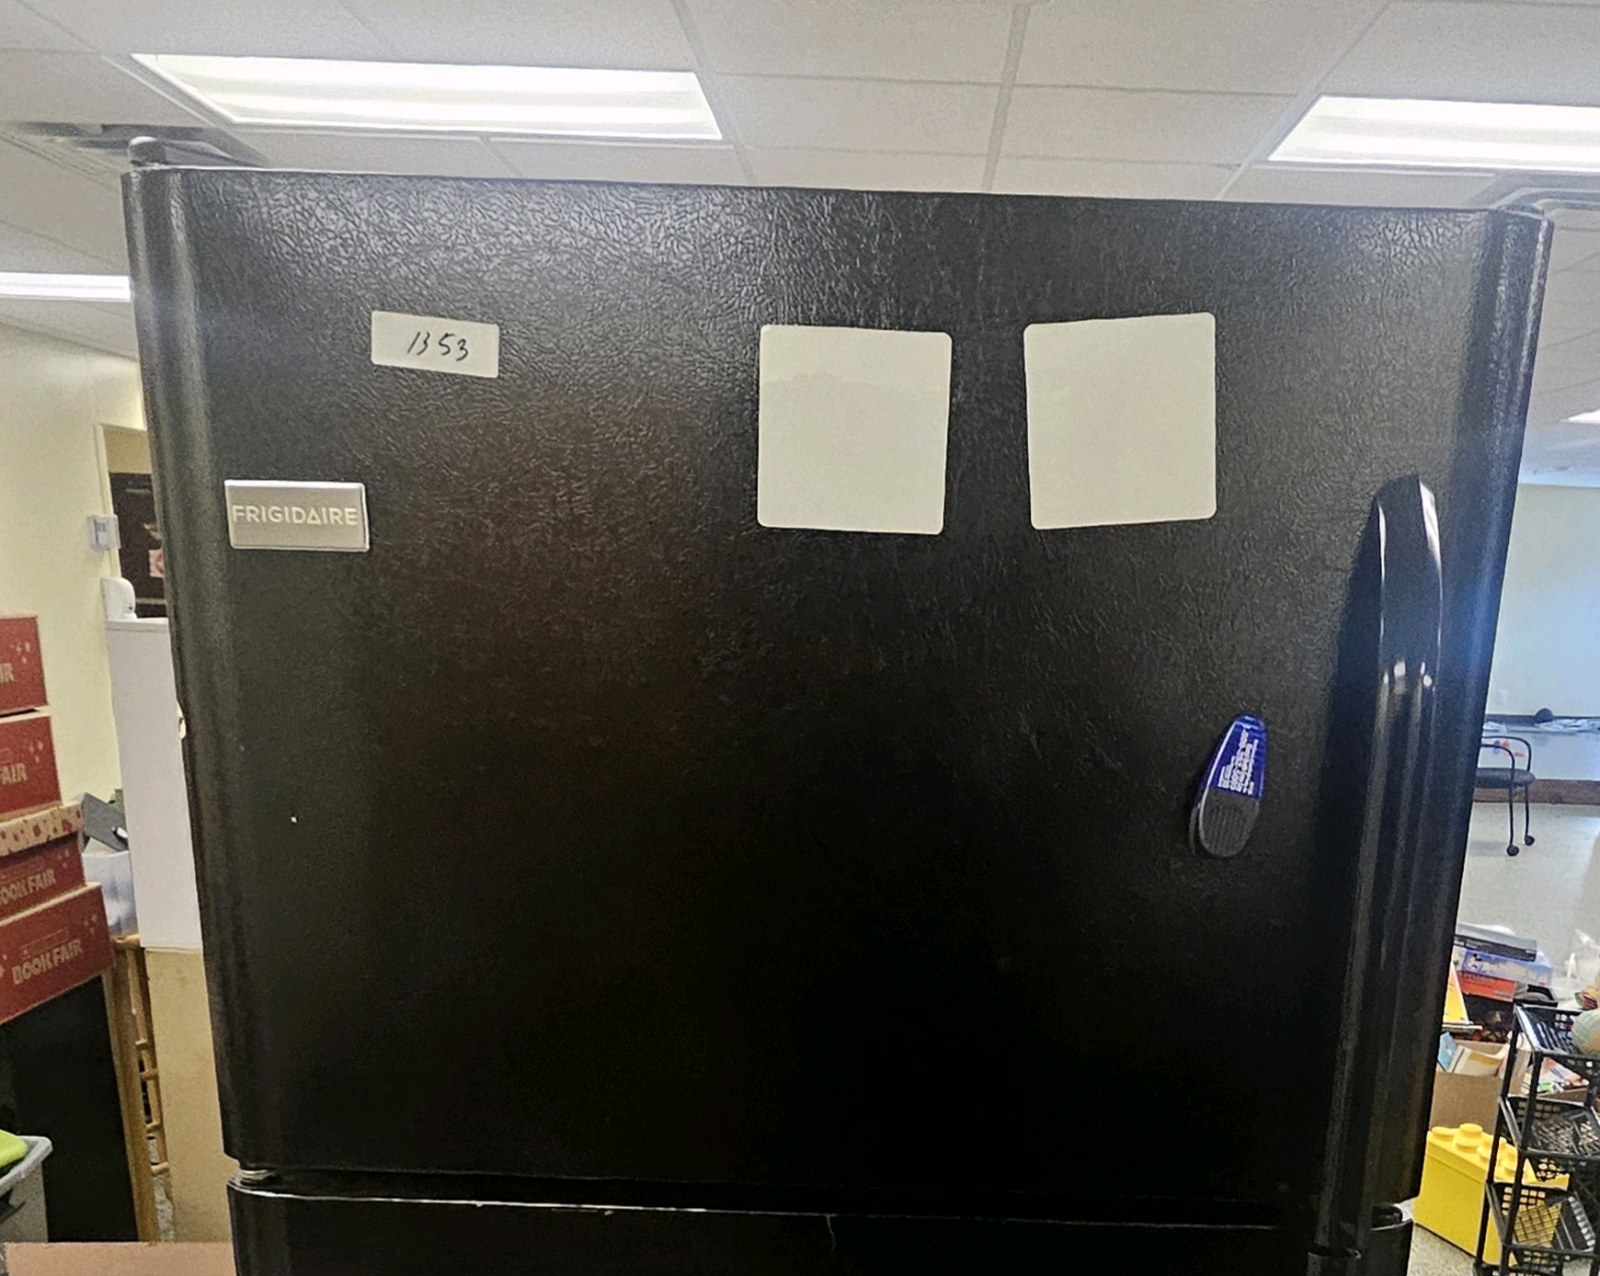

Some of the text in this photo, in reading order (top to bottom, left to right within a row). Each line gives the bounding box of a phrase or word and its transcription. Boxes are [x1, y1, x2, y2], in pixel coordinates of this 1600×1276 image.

[407, 331, 469, 361] 1353
[231, 505, 359, 526] FRIGIDAIRE
[27, 868, 56, 893] FAIR
[11, 951, 53, 985] BOOK
[52, 938, 82, 967] FAIR
